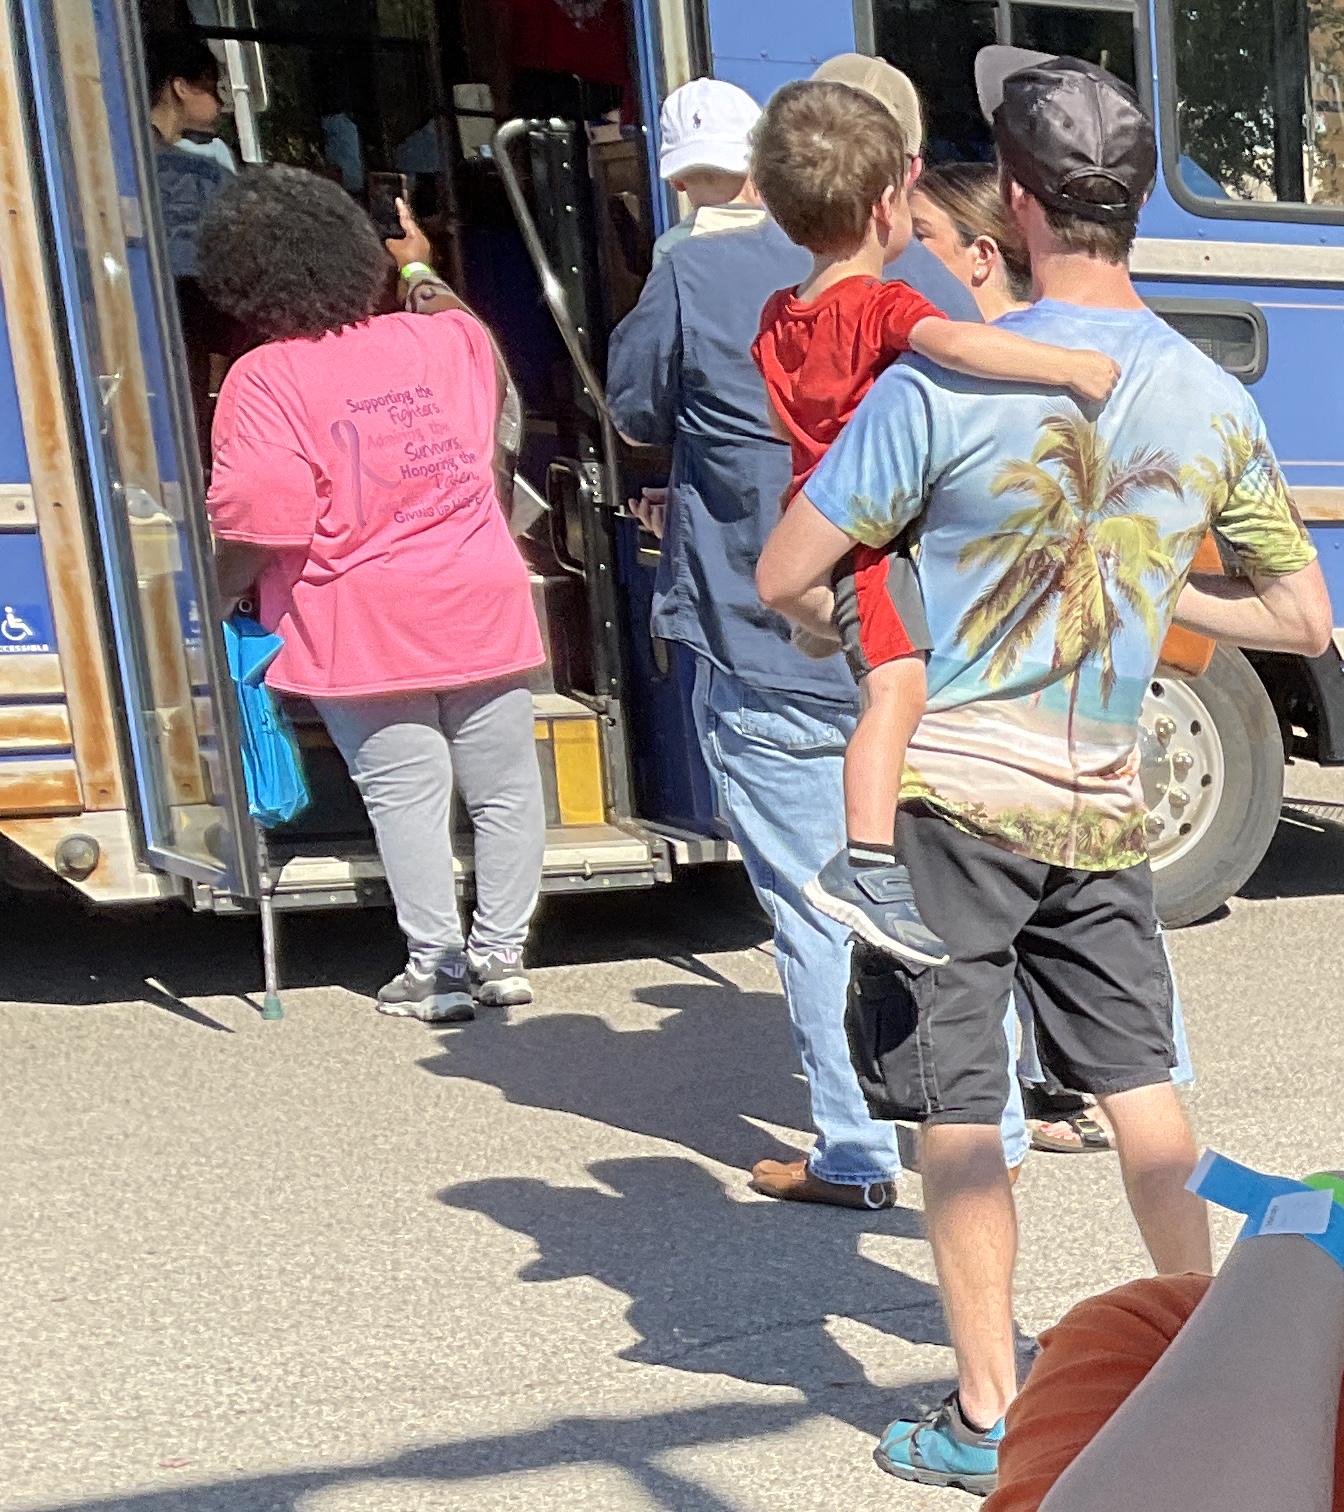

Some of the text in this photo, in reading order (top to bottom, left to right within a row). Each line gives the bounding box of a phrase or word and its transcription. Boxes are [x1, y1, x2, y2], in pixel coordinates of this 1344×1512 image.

[346, 384, 433, 414] Supporting the
[459, 451, 476, 464] the
